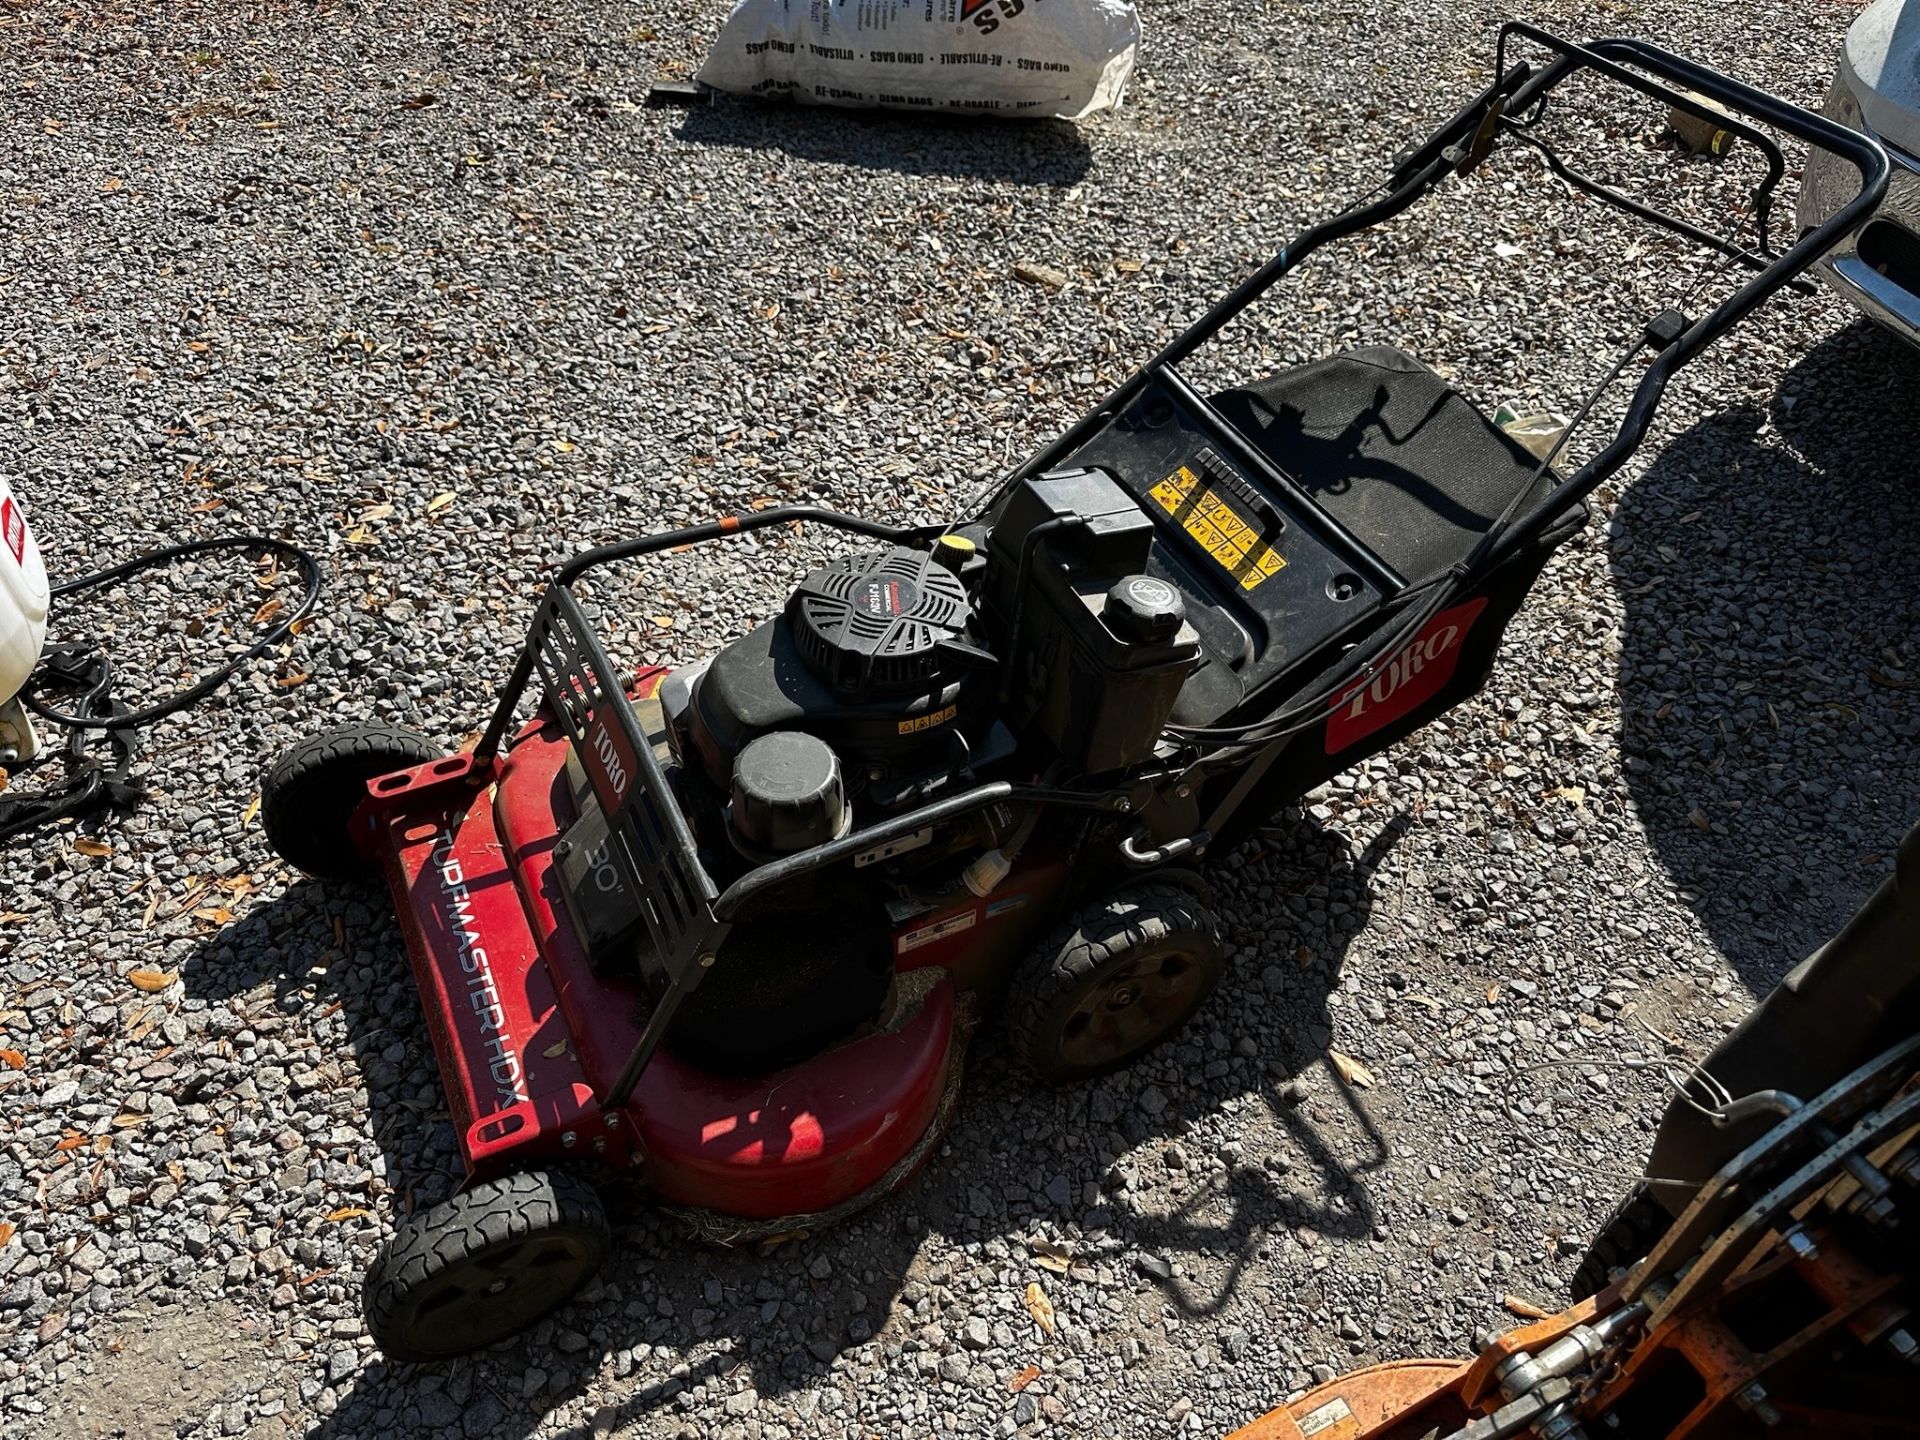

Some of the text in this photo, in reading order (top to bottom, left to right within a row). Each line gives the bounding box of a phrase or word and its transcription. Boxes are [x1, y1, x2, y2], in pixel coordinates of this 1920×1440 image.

[822, 12, 831, 36] todo!
[771, 40, 795, 54] DEMO
[870, 51, 895, 63] BAGS
[897, 52, 924, 64] DEMO
[939, 52, 1002, 67] RE-UTILSABLE
[1017, 59, 1042, 72] BAGS
[1342, 624, 1458, 722] TORO
[592, 720, 627, 796] TORO
[430, 826, 530, 1110] TURFMASTER HDX
